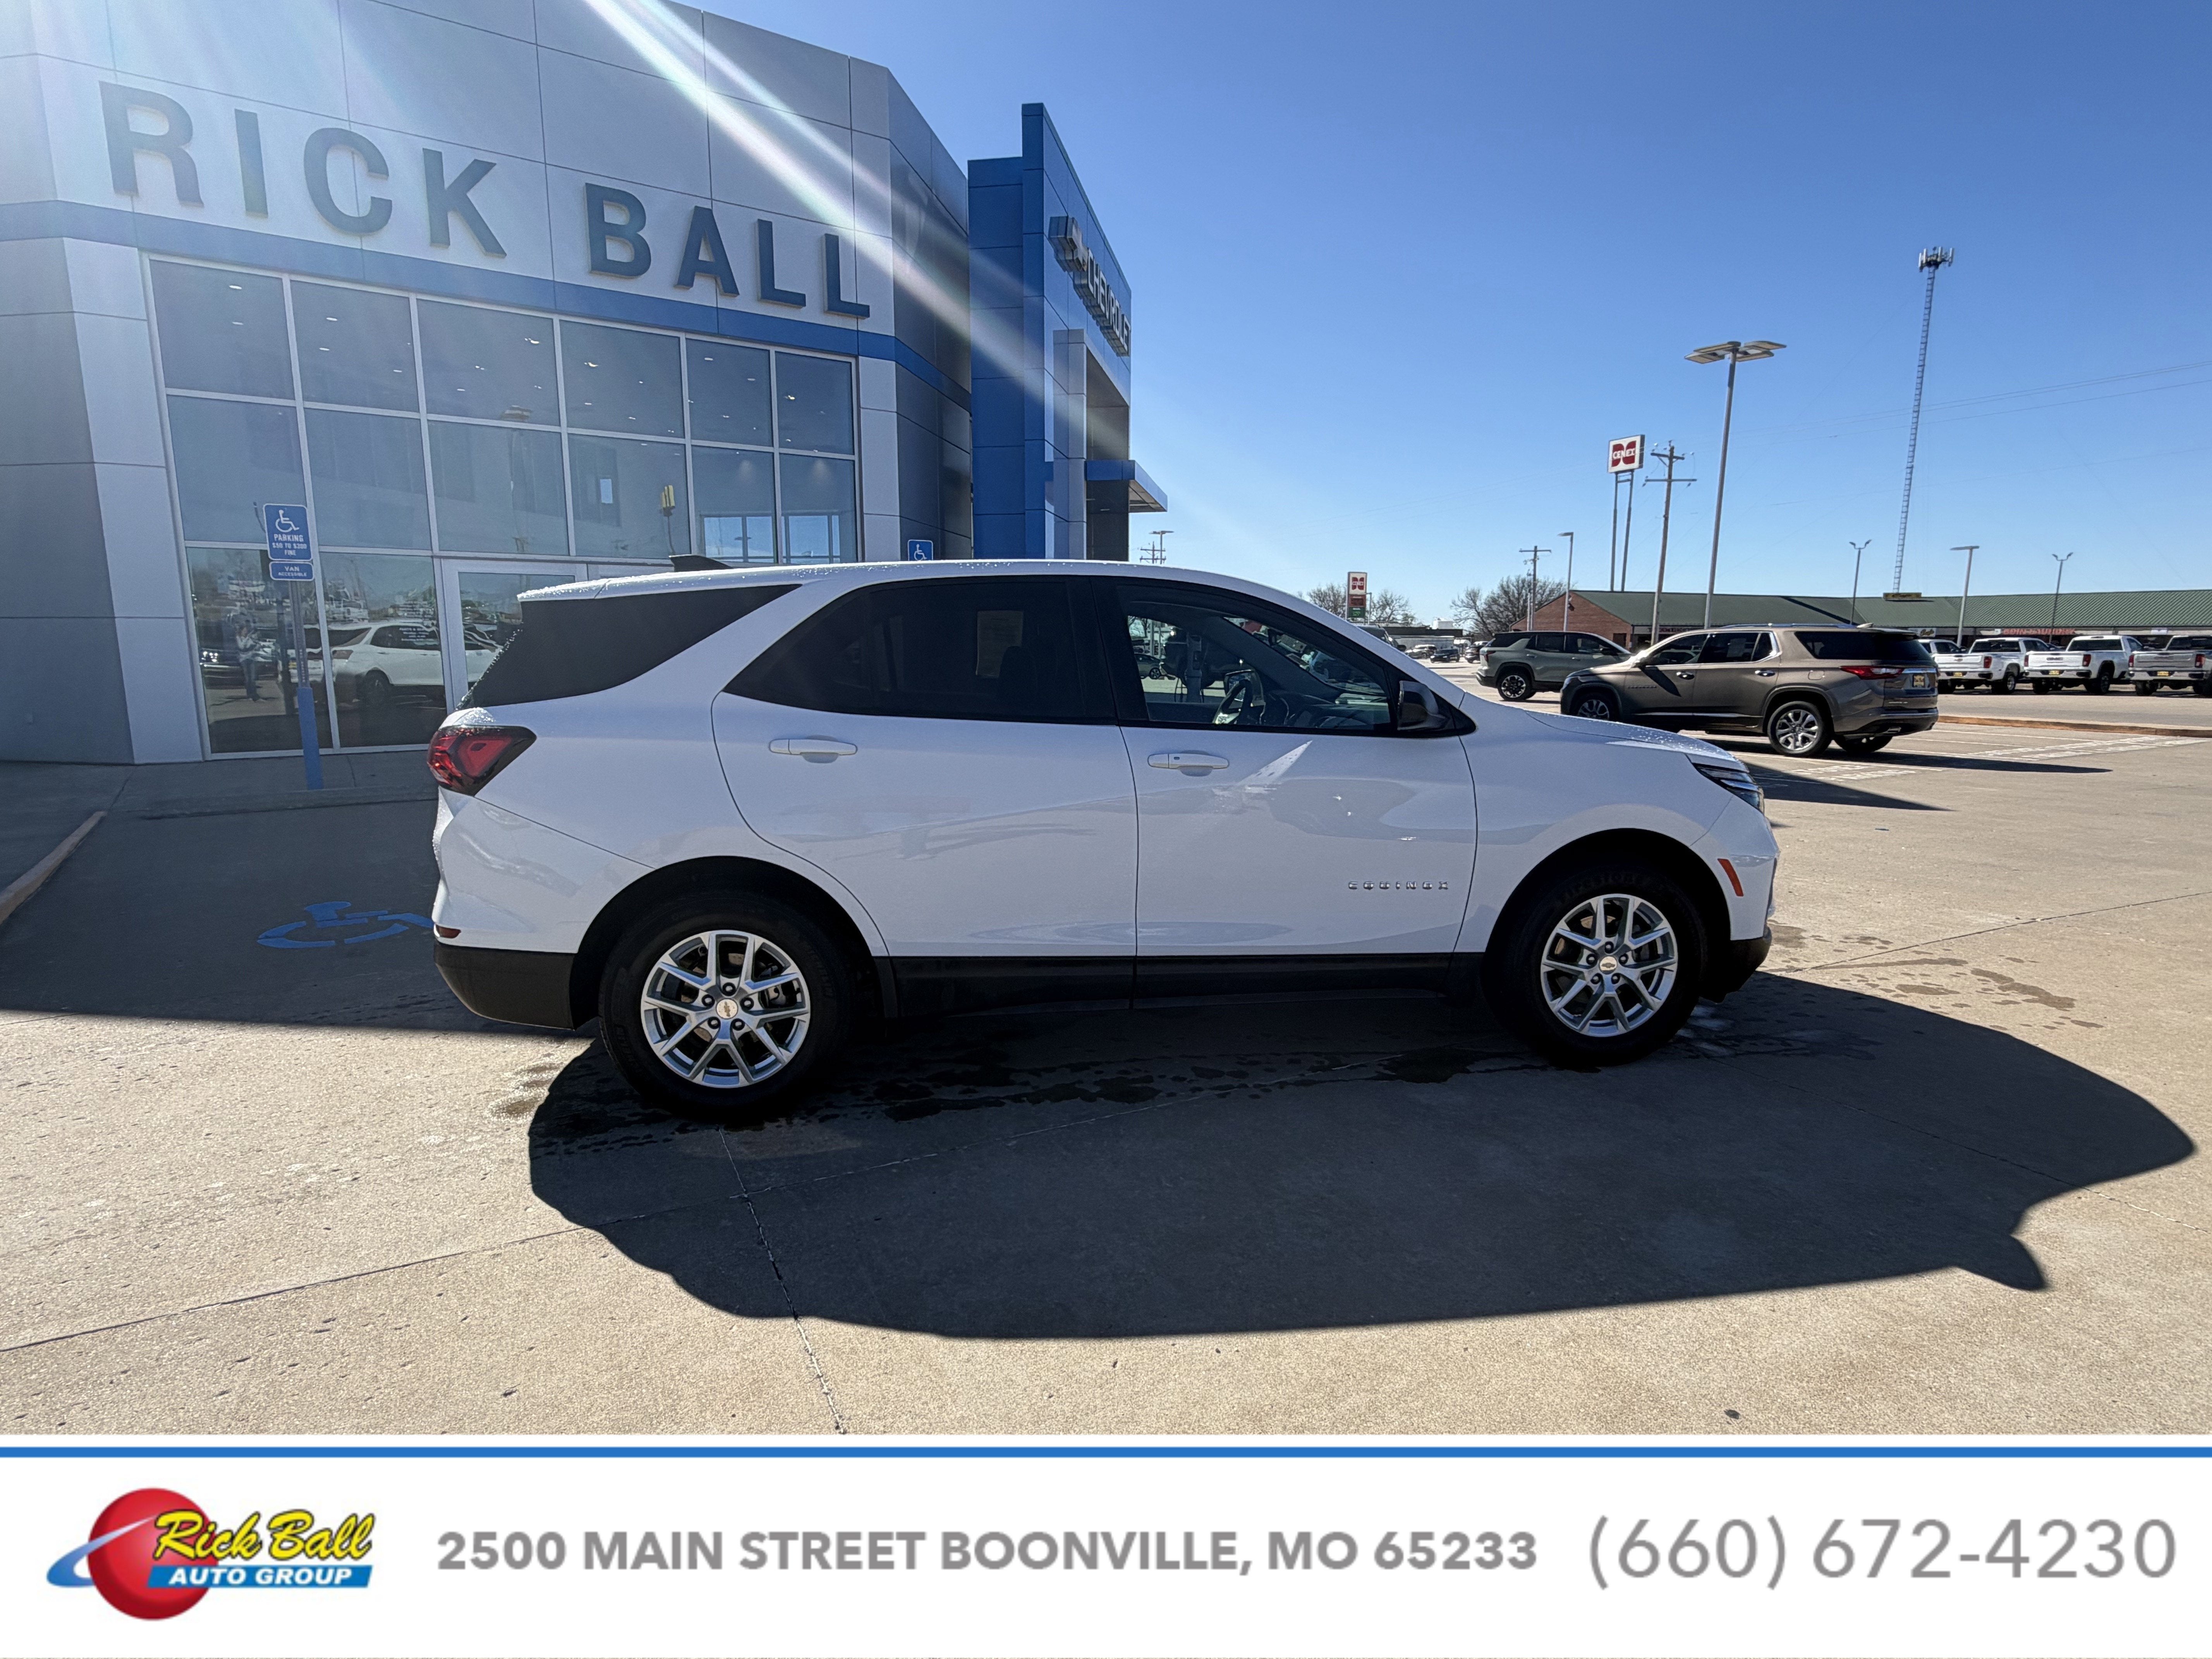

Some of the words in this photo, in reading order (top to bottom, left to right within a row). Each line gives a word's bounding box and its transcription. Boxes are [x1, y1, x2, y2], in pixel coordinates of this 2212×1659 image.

[99, 80, 507, 259] RICK
[583, 182, 870, 319] BALL
[1087, 247, 1131, 356] CHEVROLET
[1613, 448, 1636, 459] CENEX
[273, 534, 304, 542] PARKING
[1348, 881, 1448, 890] EQUINOX
